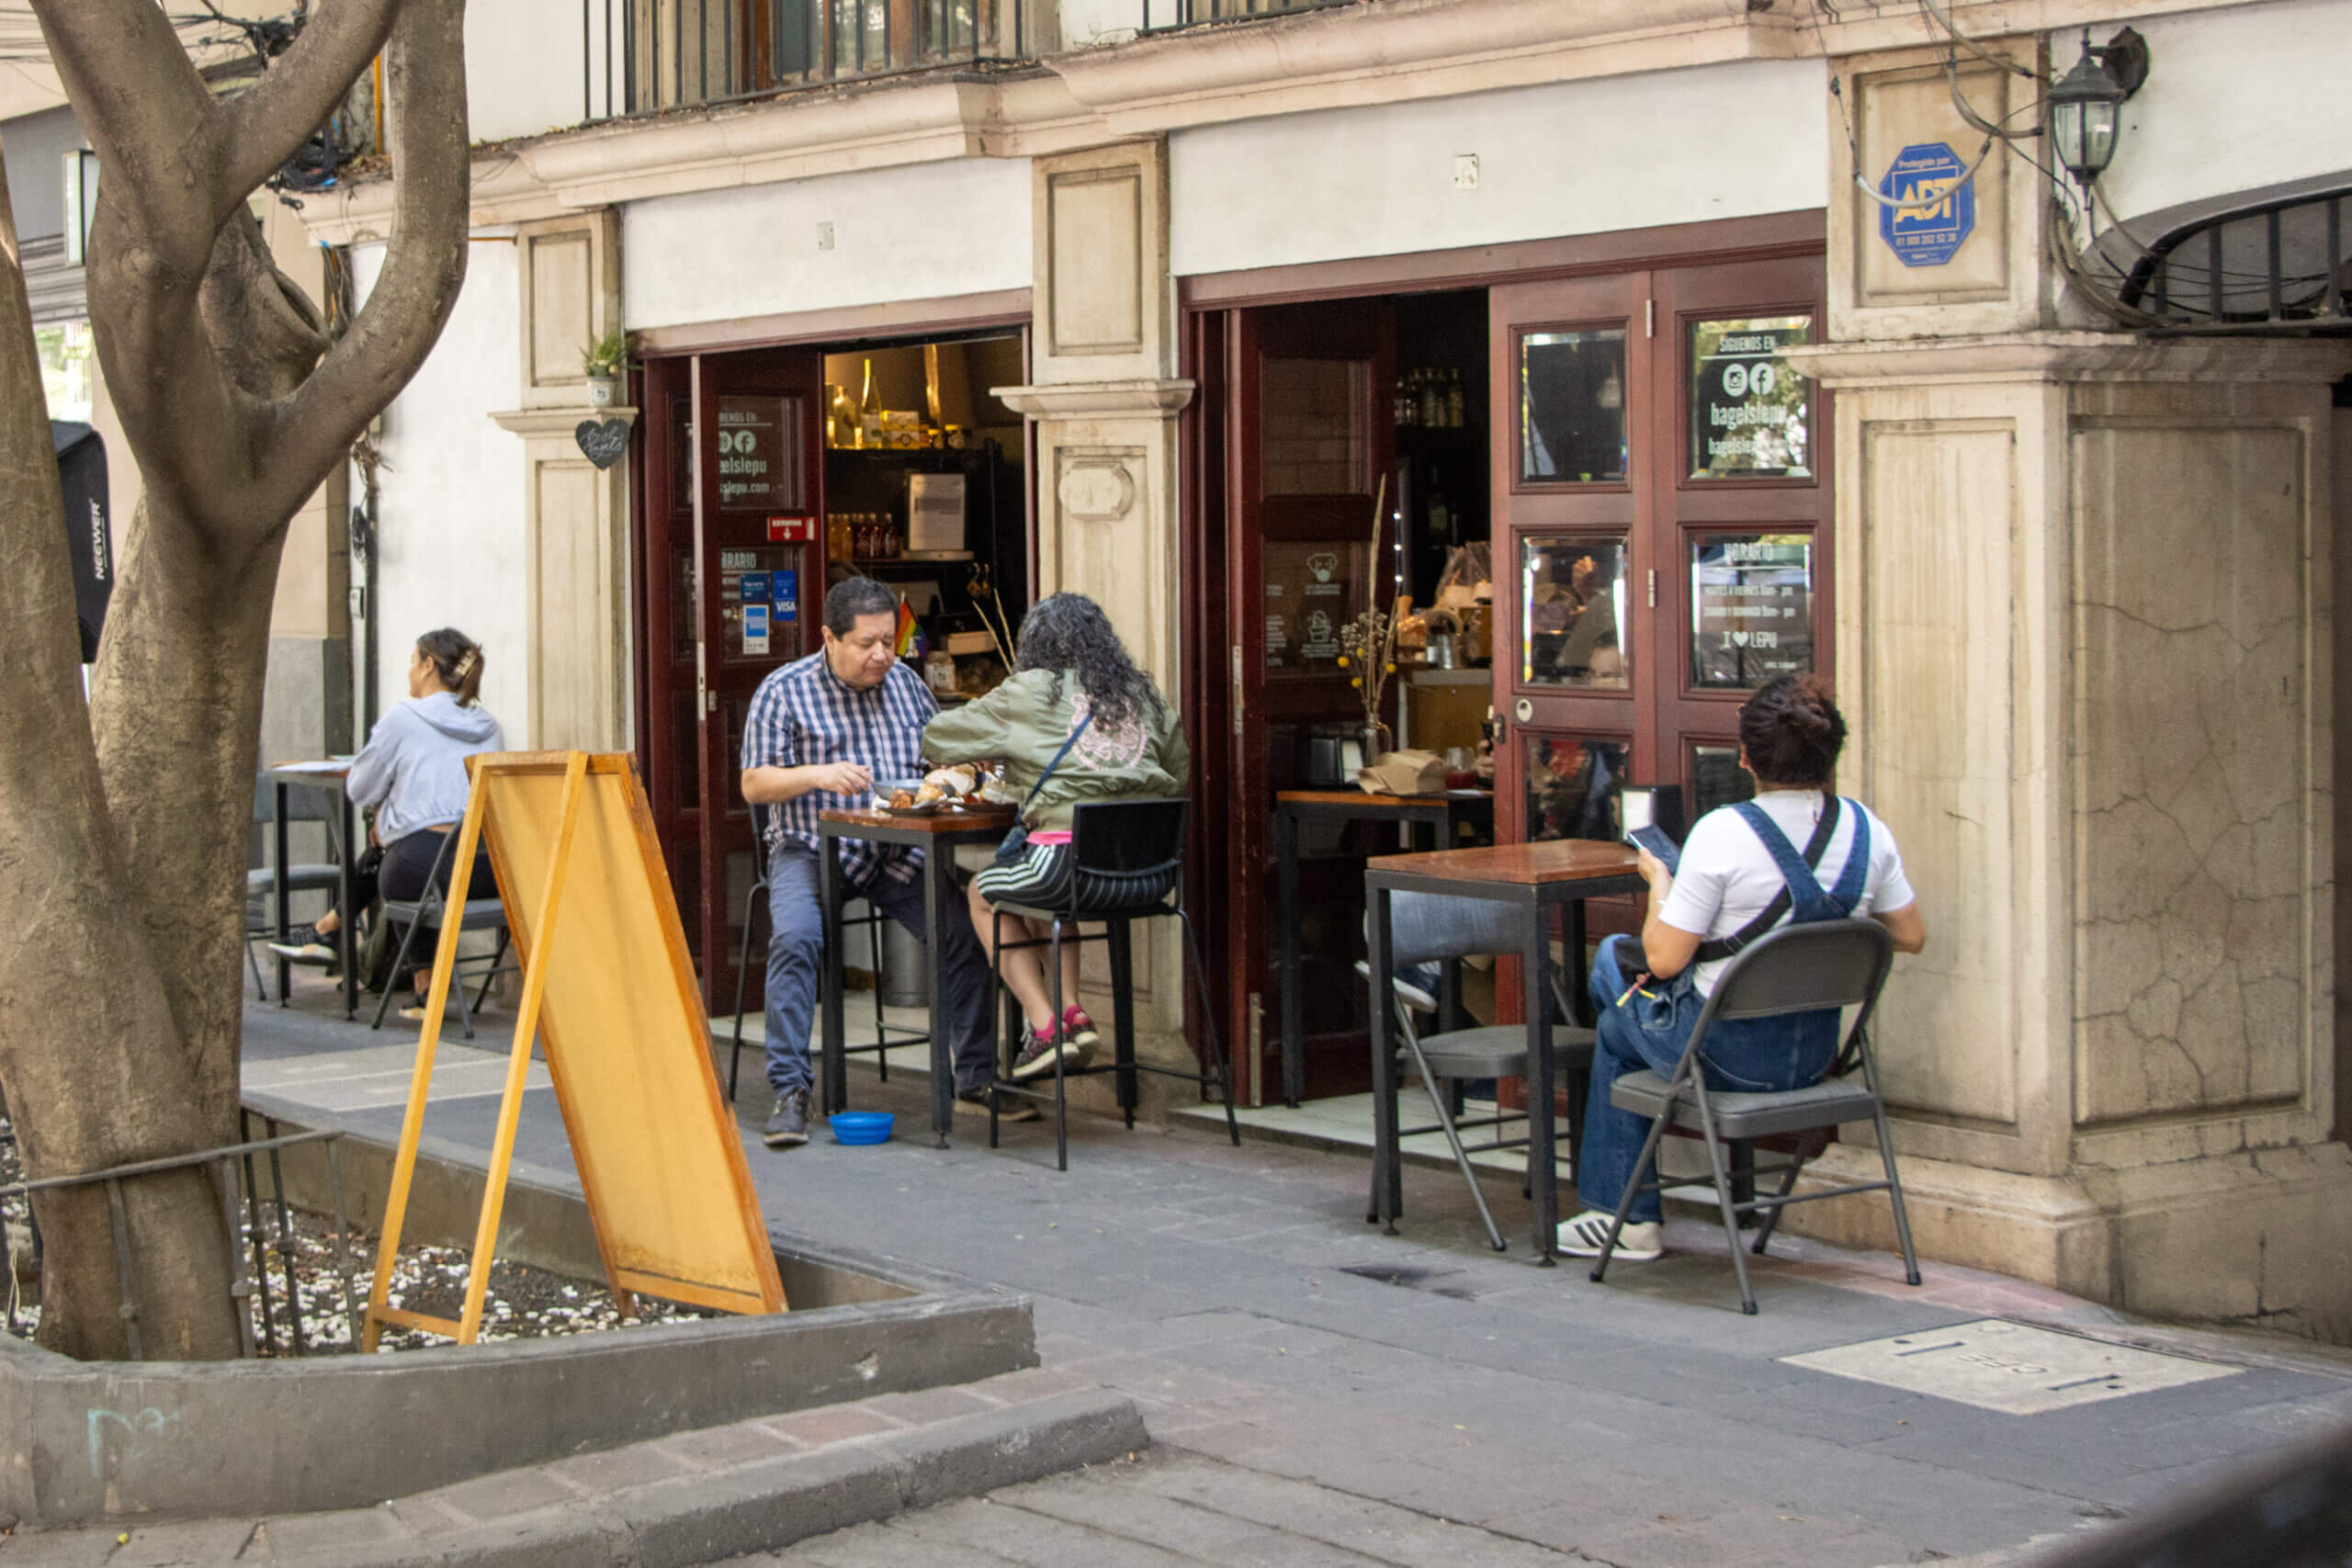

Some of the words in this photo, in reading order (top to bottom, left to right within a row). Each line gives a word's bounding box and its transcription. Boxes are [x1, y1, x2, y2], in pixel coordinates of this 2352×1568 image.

[1894, 178, 1960, 223] ADT
[91, 502, 105, 580] NEEWER
[776, 602, 797, 613] VISA
[1749, 632, 1778, 649] LEPU
